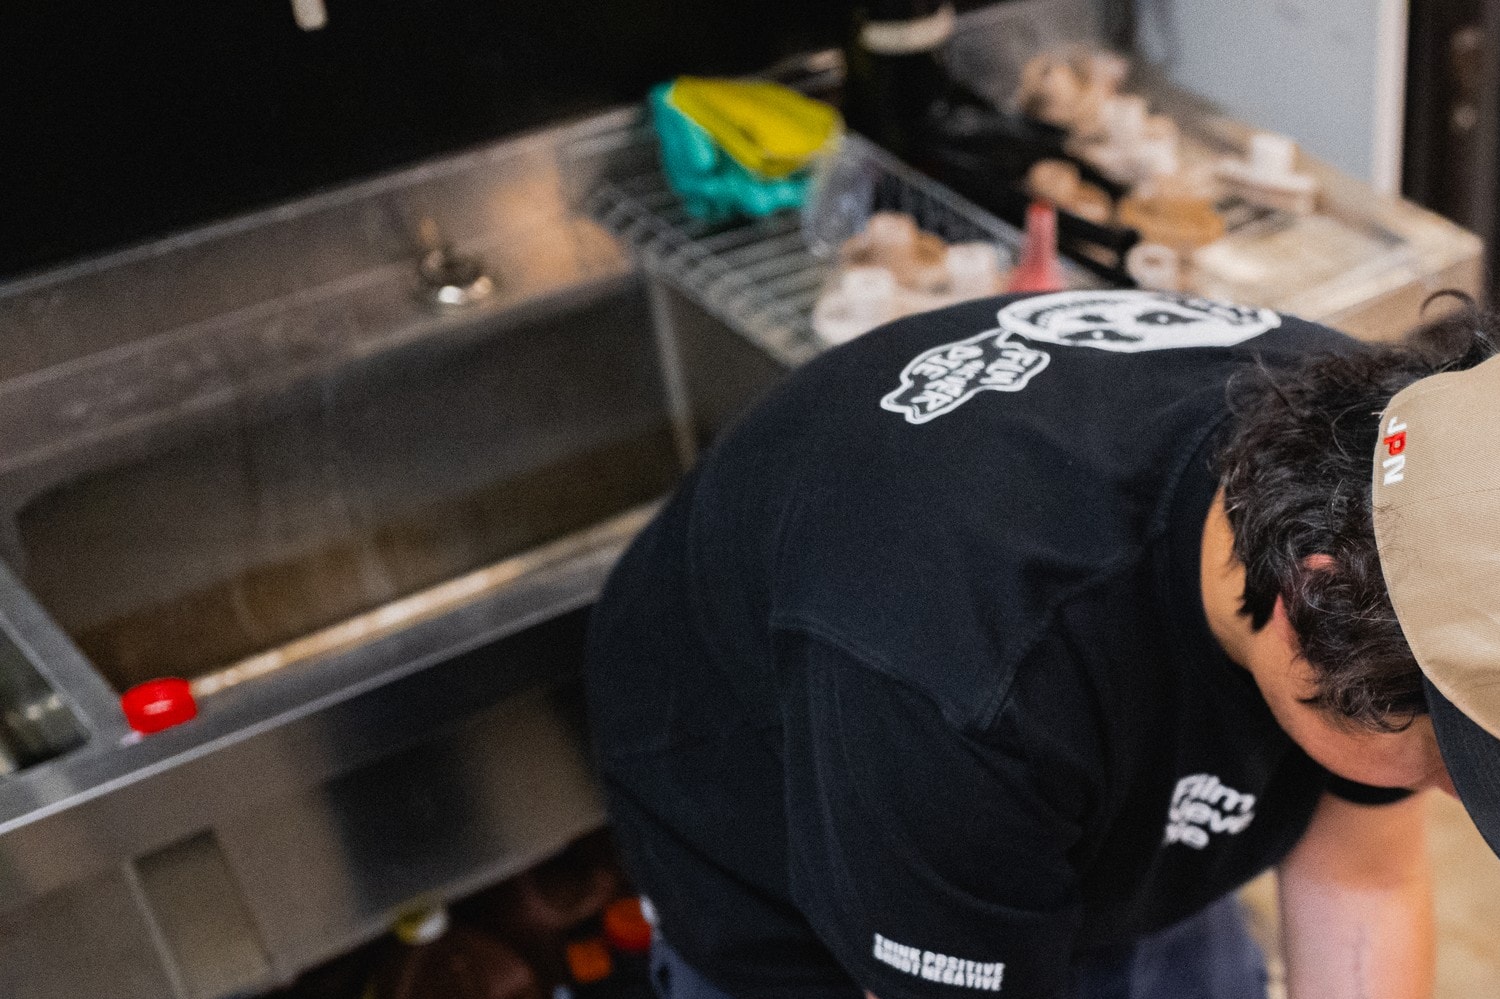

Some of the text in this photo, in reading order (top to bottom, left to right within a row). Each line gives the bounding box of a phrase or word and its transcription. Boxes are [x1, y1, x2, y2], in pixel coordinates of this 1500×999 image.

[1383, 416, 1407, 486] JPN
[920, 964, 1004, 992] NEGATIVE
[922, 950, 1006, 978] POSITIVE
